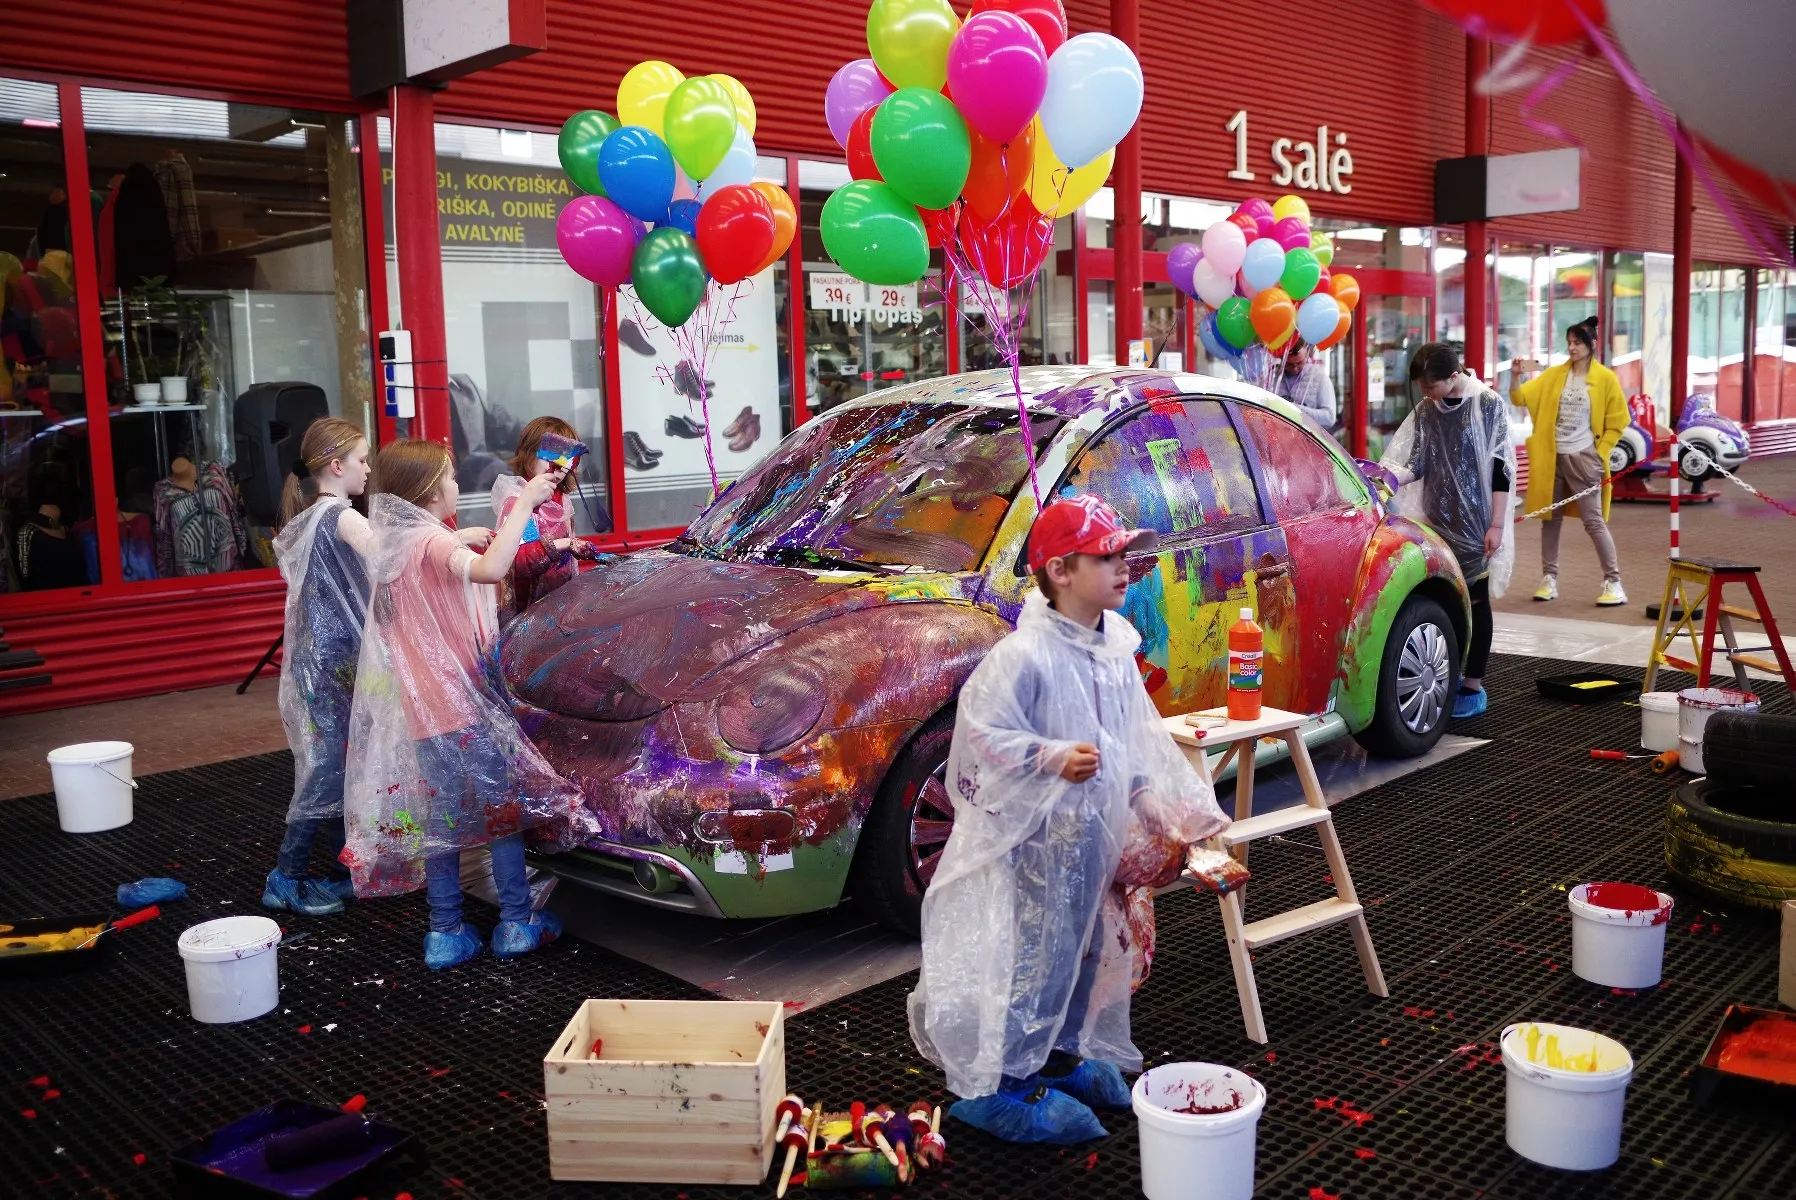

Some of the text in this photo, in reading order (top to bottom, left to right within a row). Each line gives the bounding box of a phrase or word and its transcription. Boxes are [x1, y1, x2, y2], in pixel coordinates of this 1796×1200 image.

[1225, 110, 1353, 194] 1 salė
[466, 173, 574, 197] KOKYBIŠKA,
[502, 199, 557, 219] ODINĖ
[445, 222, 525, 242] AVALYNĖ
[882, 290, 898, 306] 29
